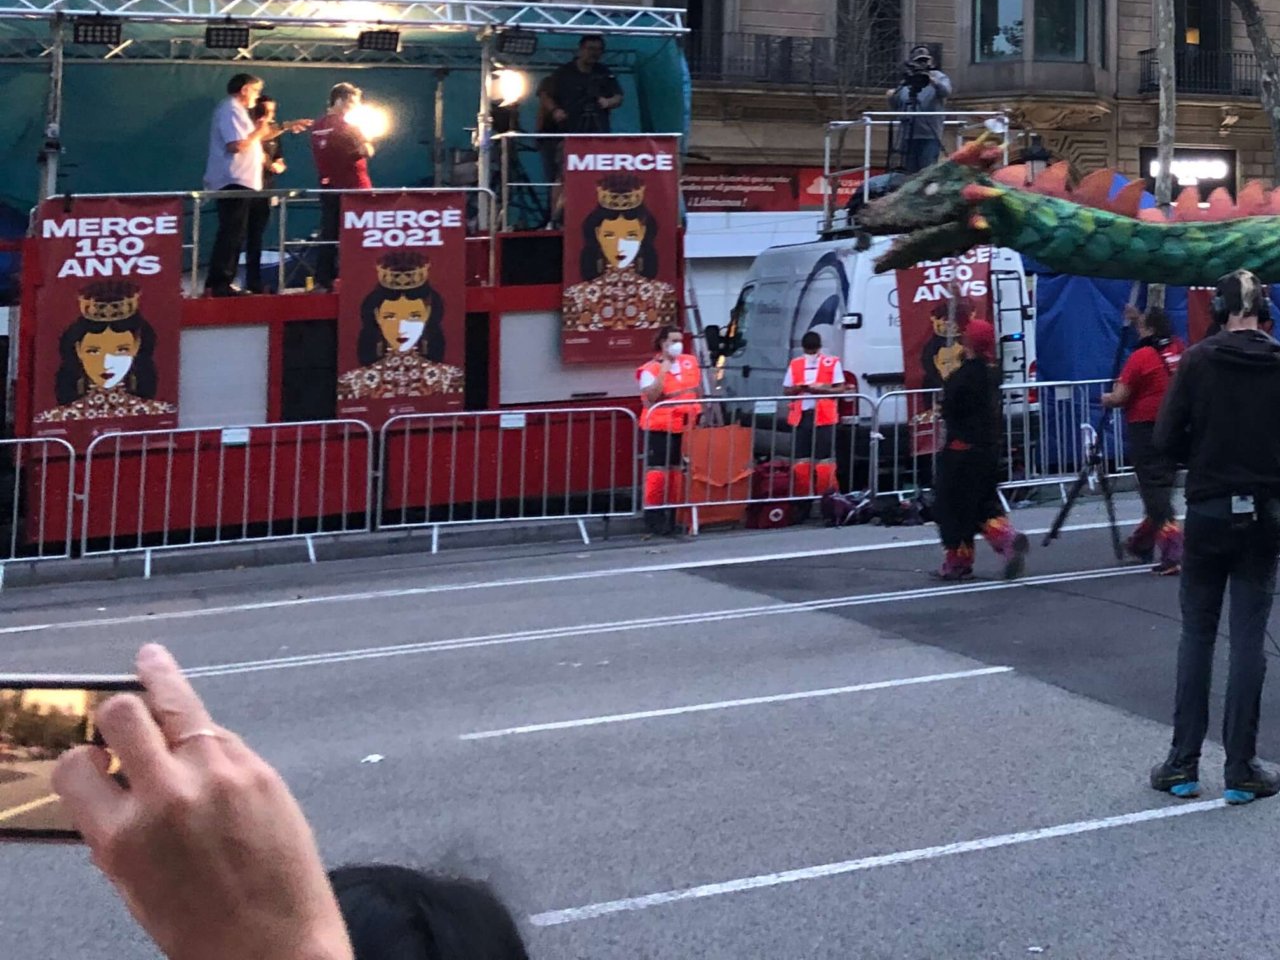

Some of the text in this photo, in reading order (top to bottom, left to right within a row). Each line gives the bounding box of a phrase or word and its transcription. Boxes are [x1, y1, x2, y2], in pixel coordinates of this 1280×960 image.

[566, 150, 674, 171] MERCÈ
[43, 212, 178, 238] MERCÈ
[344, 206, 462, 229] MERCÈ
[75, 237, 144, 257] 150
[362, 228, 444, 247] 2021
[57, 255, 161, 278] ANYS
[923, 265, 973, 284] 150
